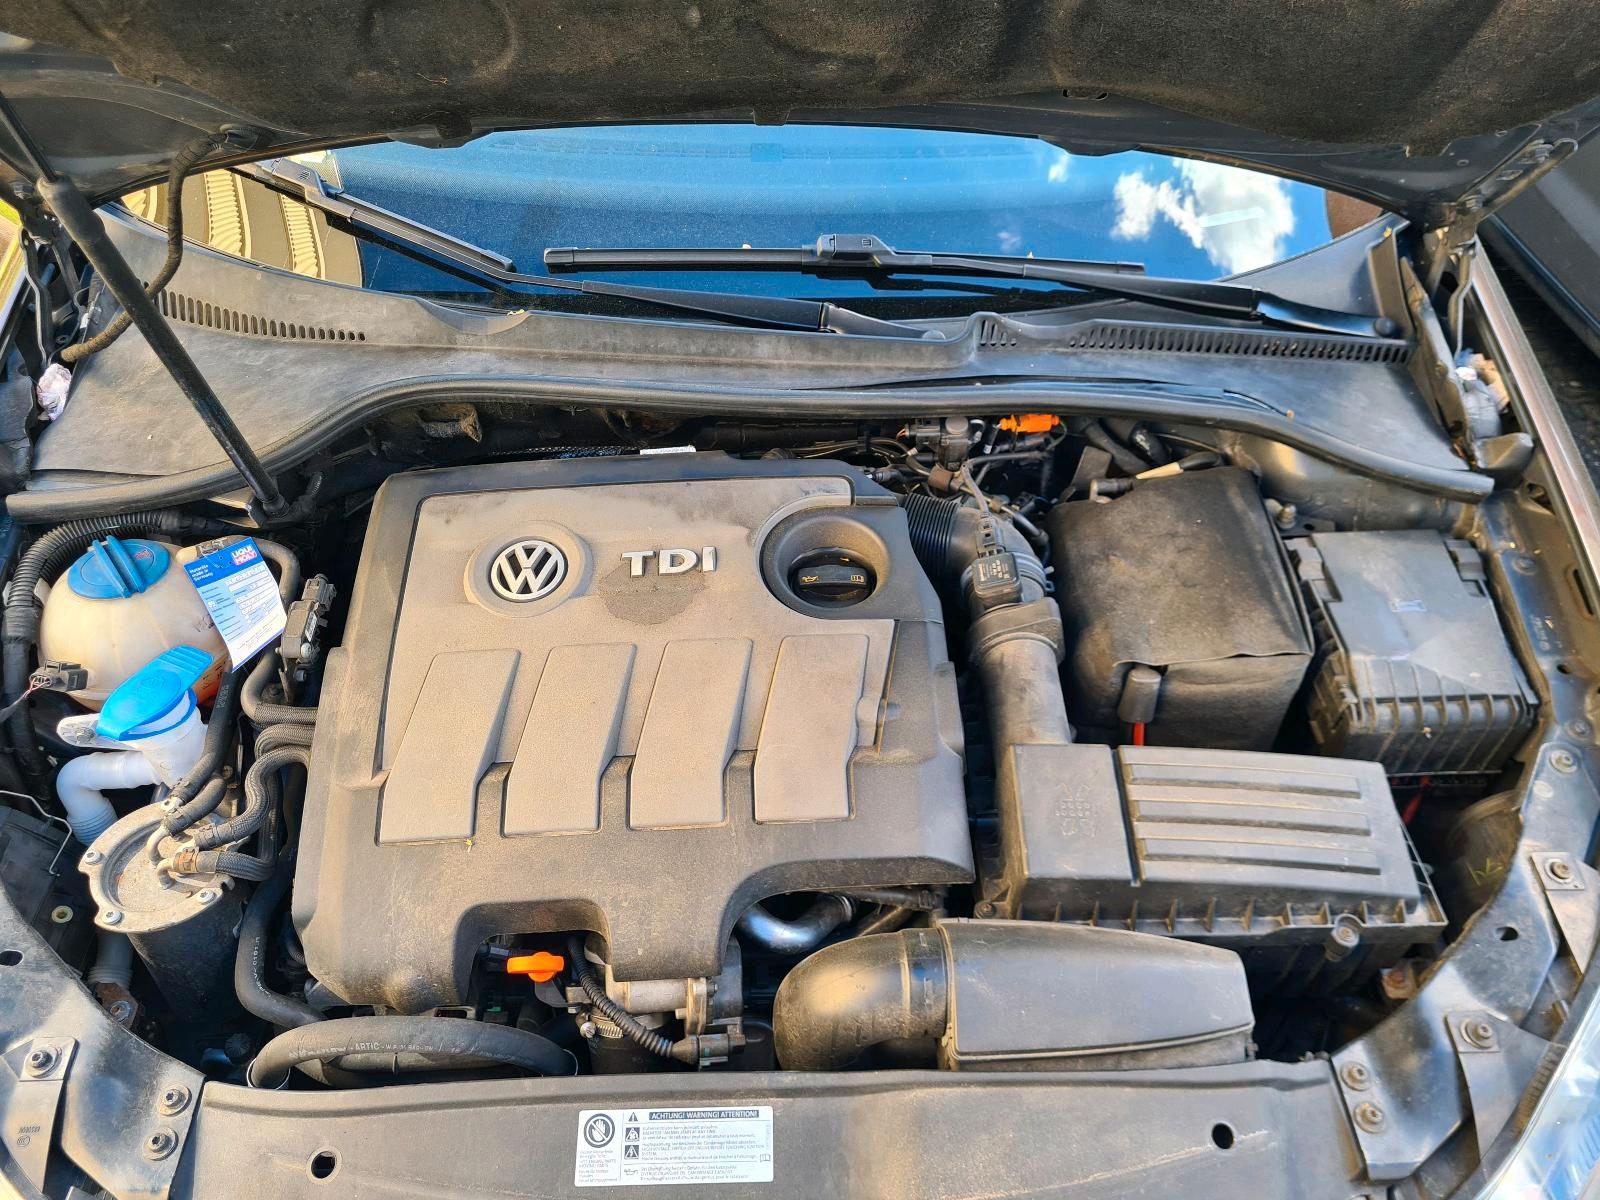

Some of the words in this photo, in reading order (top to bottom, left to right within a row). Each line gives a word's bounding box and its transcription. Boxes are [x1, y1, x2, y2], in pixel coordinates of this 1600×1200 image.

[621, 546, 717, 577] TDI
[651, 1111, 685, 1120] ACHTUNG!
[686, 1111, 719, 1119] WARNING!
[720, 1110, 758, 1118] ATTENTION!
